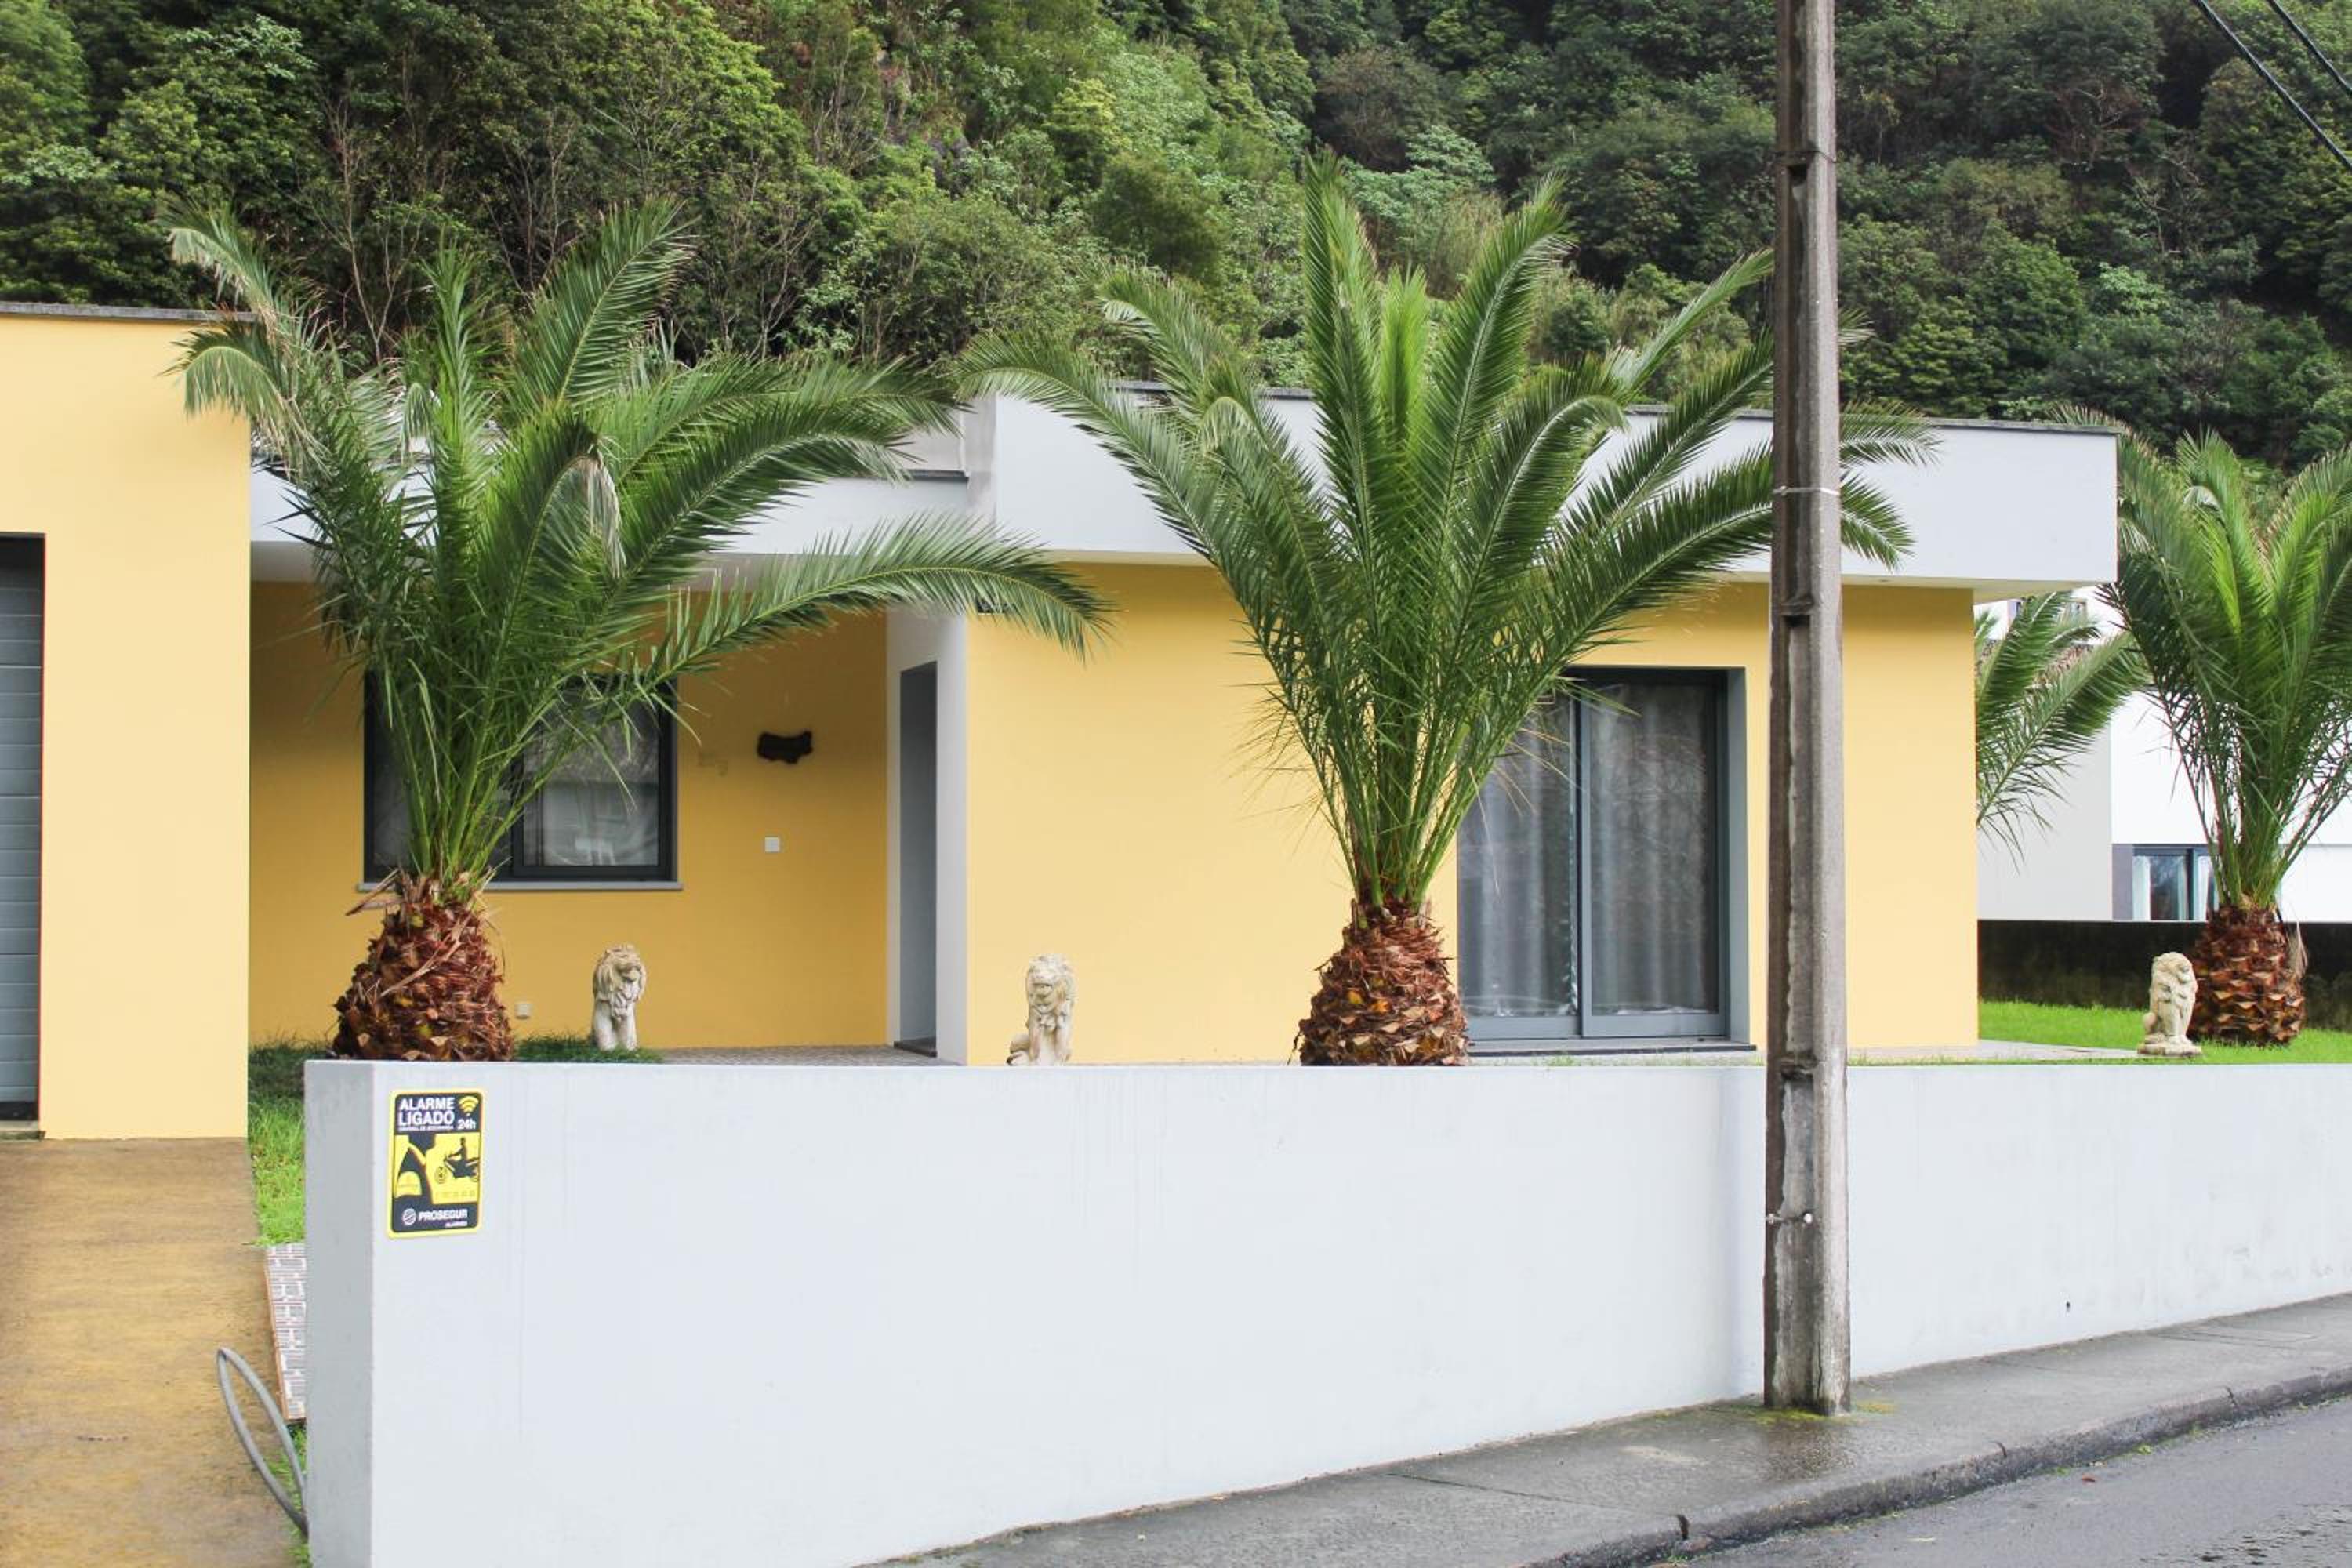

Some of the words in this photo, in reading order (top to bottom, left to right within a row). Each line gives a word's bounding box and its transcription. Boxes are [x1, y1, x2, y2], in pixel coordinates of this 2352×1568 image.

[400, 1098, 455, 1110] ALARME
[398, 1110, 455, 1126] LIGADO
[457, 1118, 476, 1130] 24h
[418, 1209, 468, 1221] PROSEGUR
